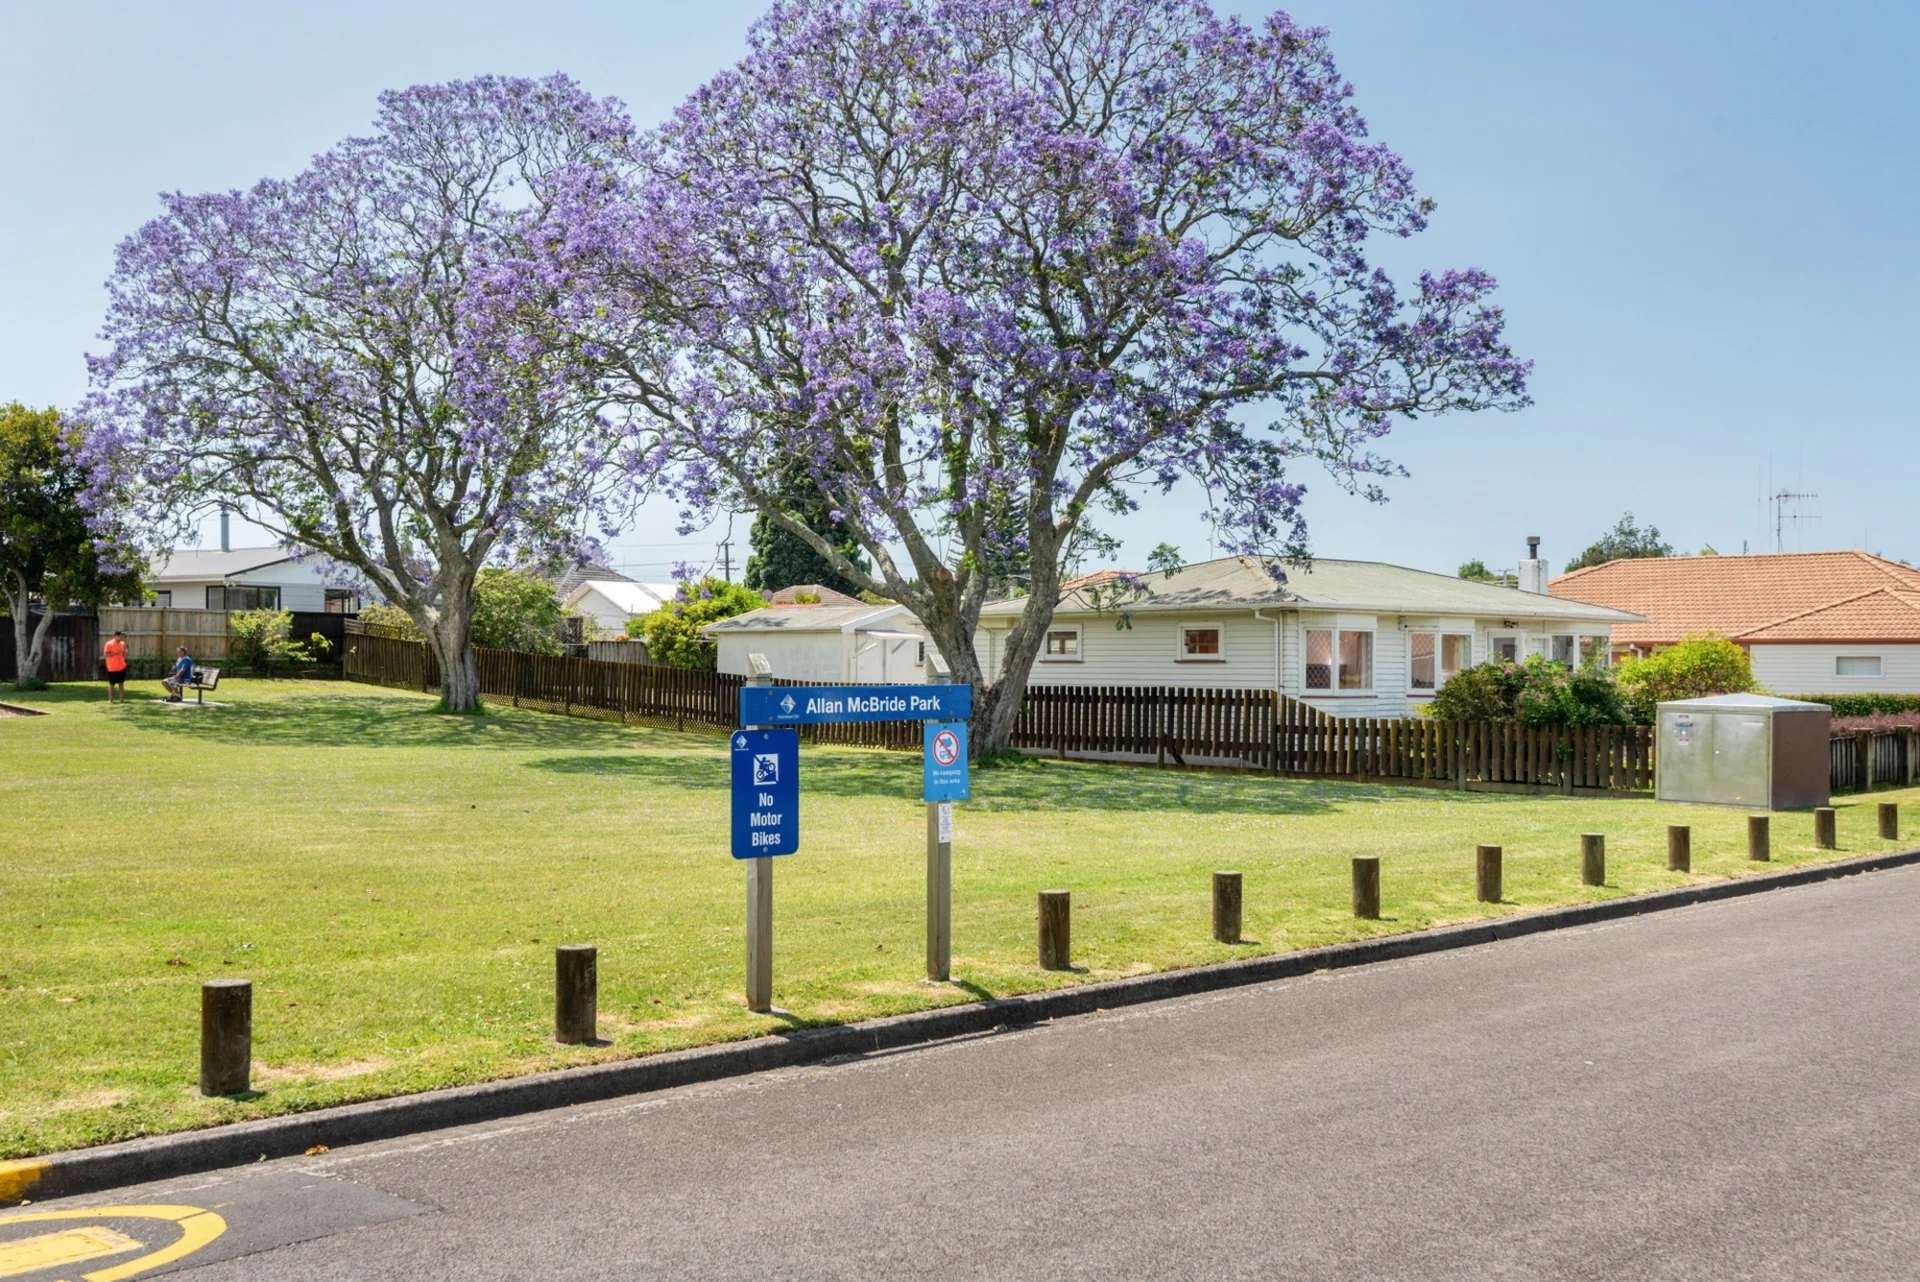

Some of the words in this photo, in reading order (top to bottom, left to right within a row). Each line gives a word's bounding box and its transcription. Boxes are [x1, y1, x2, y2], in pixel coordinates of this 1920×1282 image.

[806, 697, 843, 714] Allan
[847, 696, 907, 713] McBride
[910, 695, 941, 711] Park
[759, 792, 774, 807] No
[750, 812, 783, 827] Motor
[752, 831, 781, 847] Bikes
